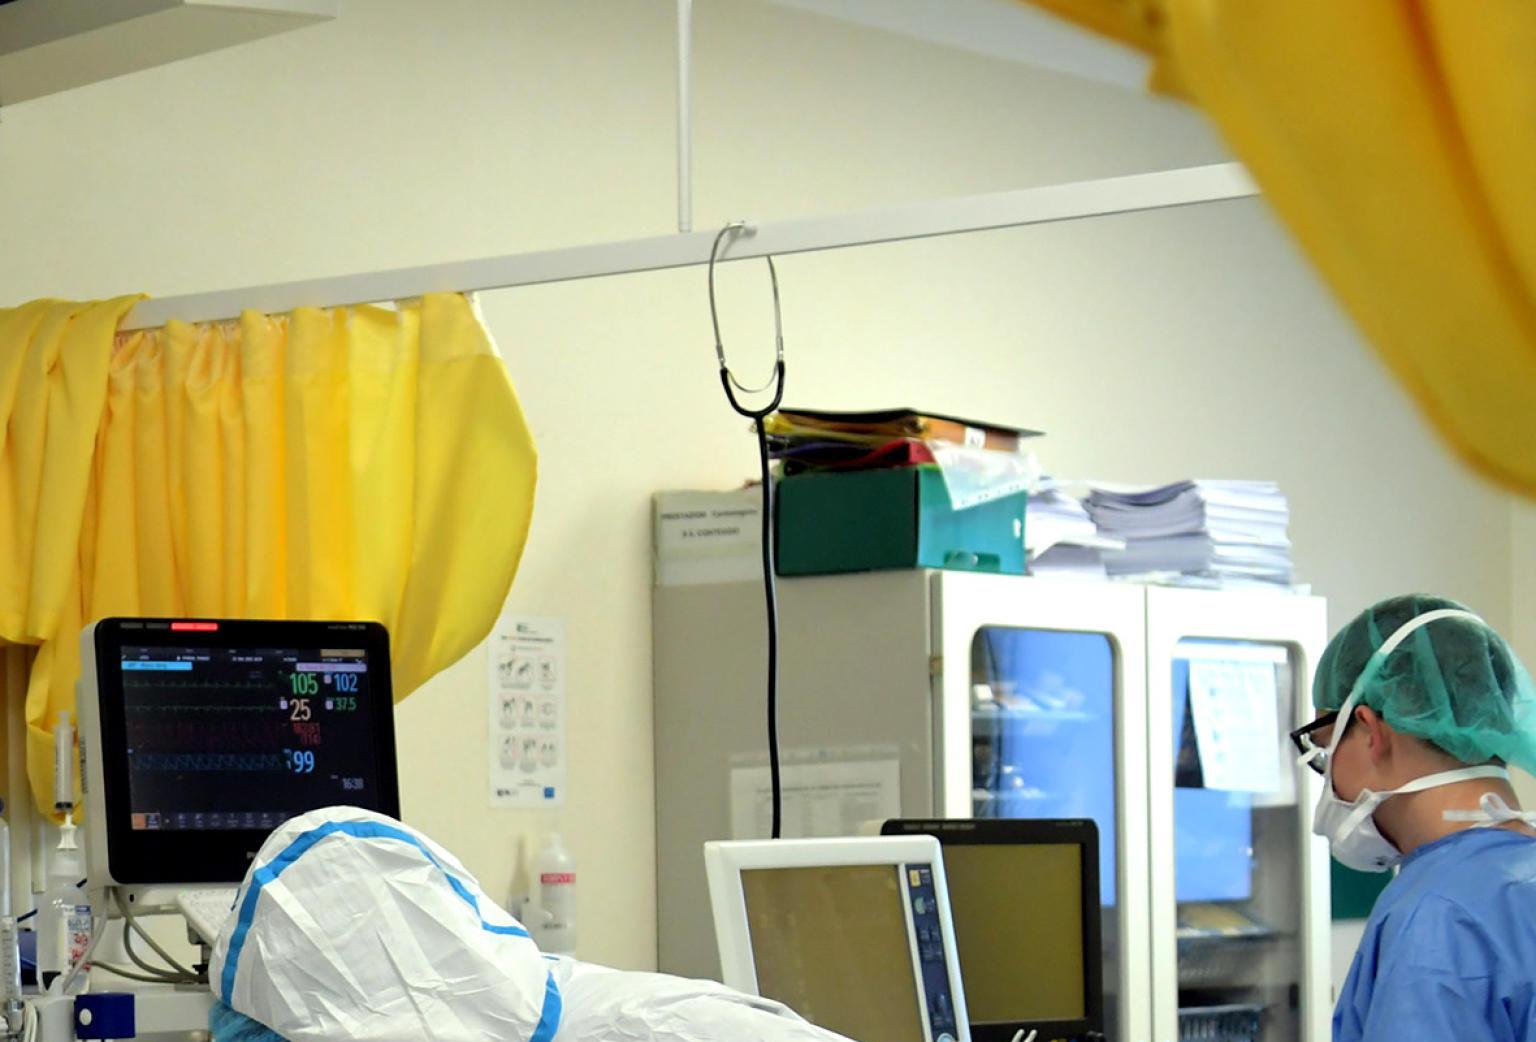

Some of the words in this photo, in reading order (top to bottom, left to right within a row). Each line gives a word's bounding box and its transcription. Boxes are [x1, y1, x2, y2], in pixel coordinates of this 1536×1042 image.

[290, 673, 319, 695] 105
[334, 673, 359, 692] 102
[290, 698, 312, 720] 25
[293, 750, 315, 773] 99
